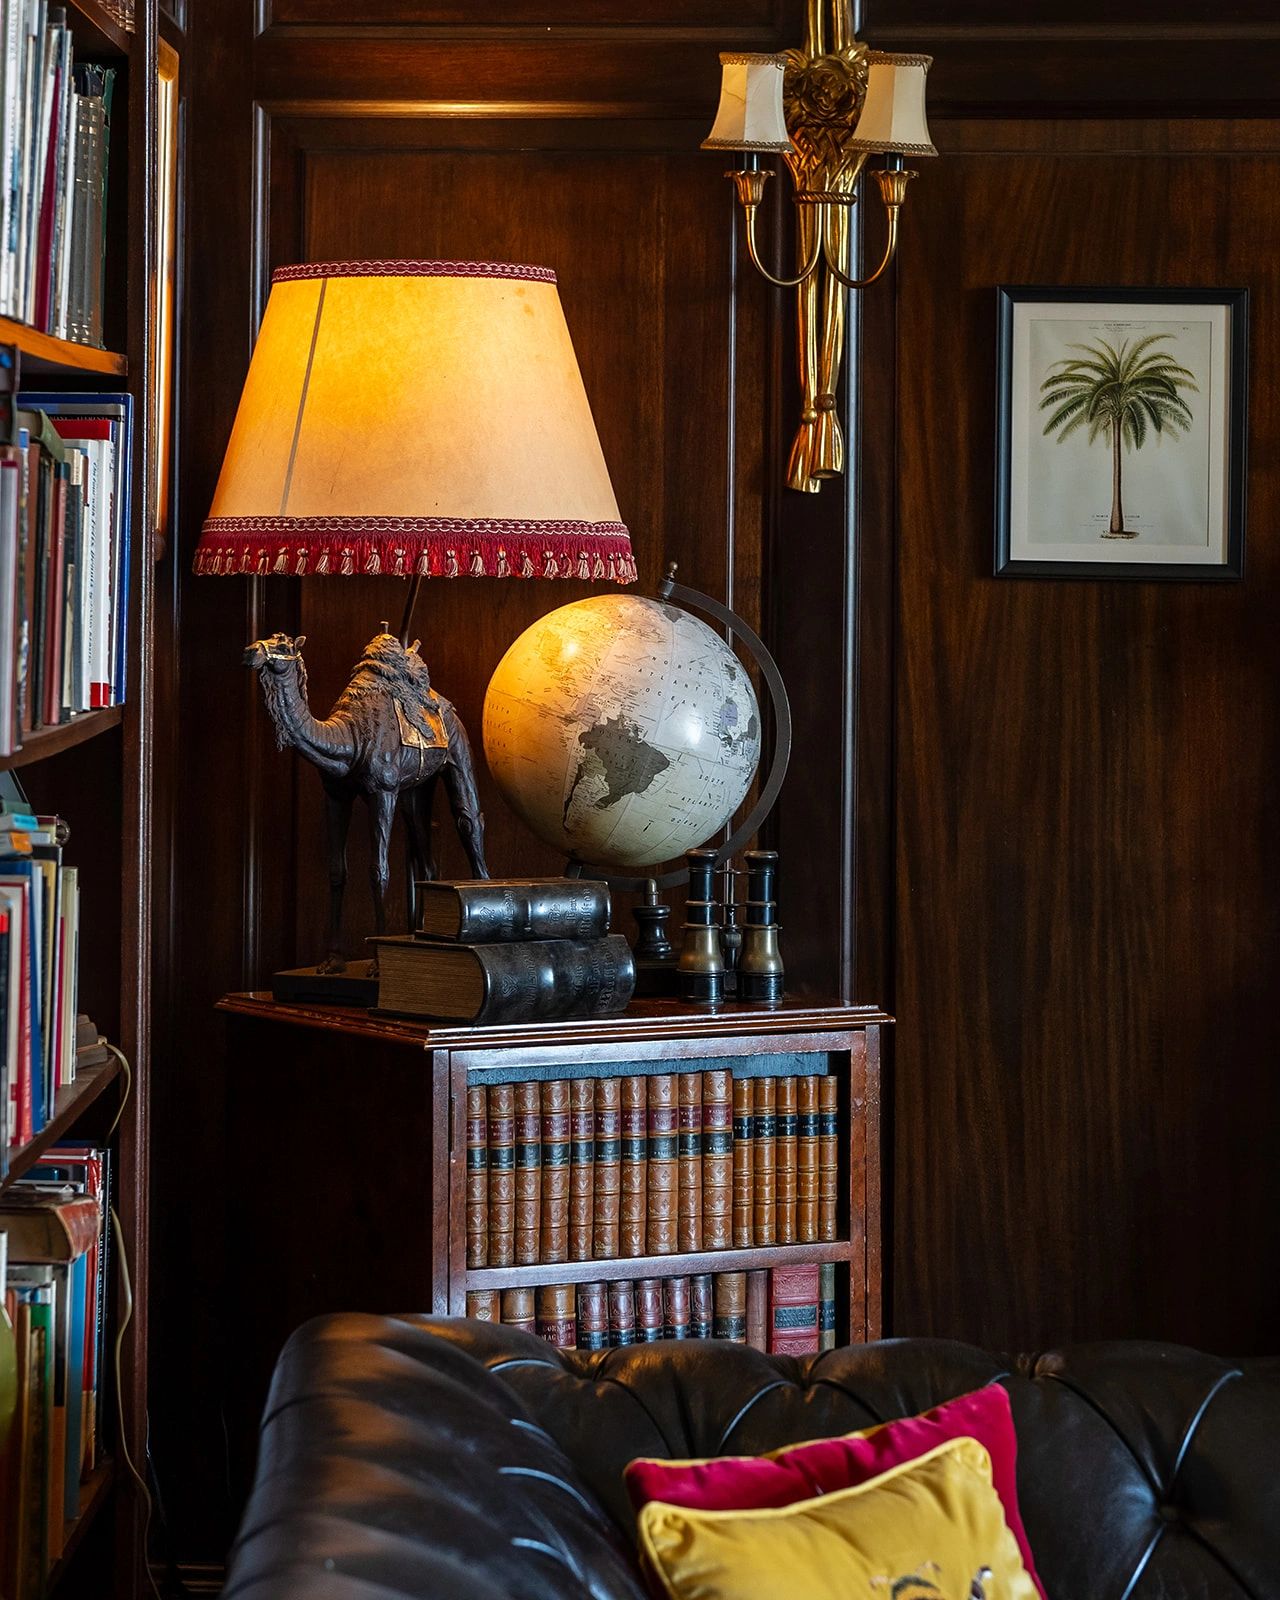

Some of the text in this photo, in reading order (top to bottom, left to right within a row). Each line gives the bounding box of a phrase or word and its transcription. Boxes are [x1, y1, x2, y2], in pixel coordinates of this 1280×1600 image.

[651, 656, 703, 676] NORTH
[638, 668, 716, 698] ATLANTIC
[645, 687, 697, 708] OCEAN
[681, 796, 720, 810] ATLANTIC
